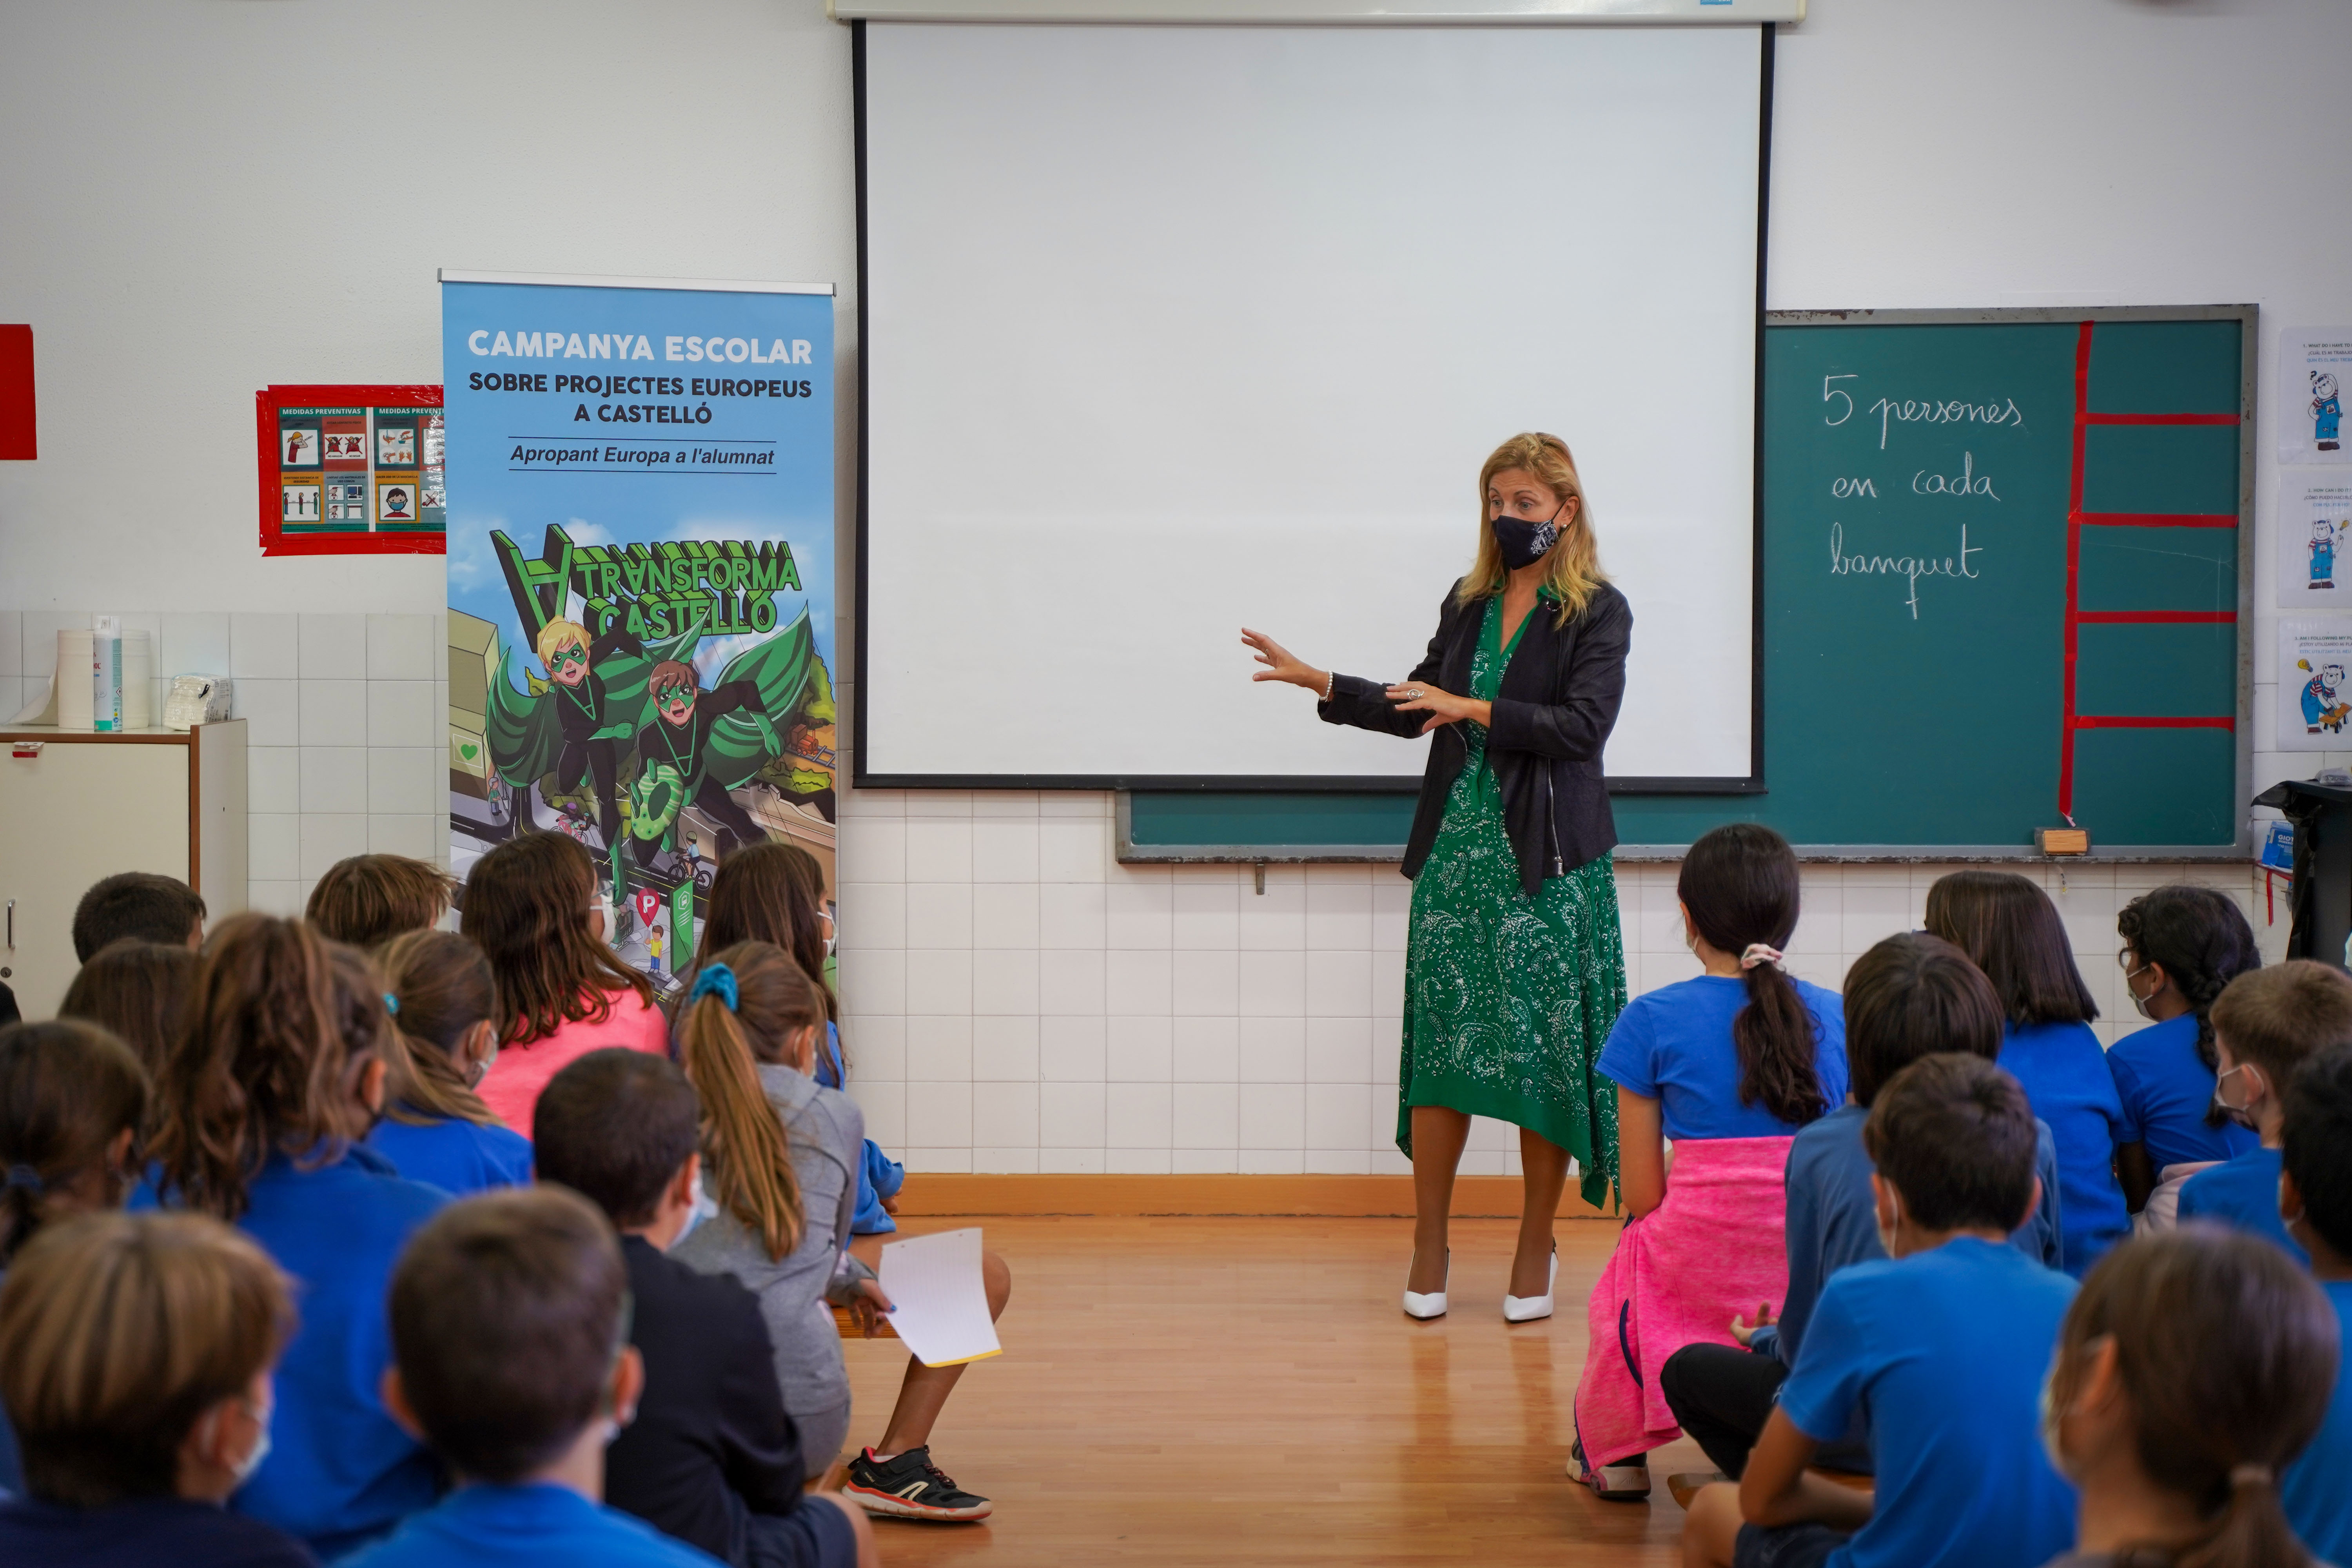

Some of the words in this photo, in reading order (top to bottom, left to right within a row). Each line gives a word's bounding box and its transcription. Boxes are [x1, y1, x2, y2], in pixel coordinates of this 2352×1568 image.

[469, 330, 655, 360] CAMPANYA
[666, 336, 812, 364] ESCOLAR
[470, 372, 548, 392] SOBRE
[555, 375, 684, 398] PROJECTES
[692, 377, 812, 397] EUROPEUS
[574, 403, 590, 422] A
[597, 401, 712, 424] CASTELLÓ
[1824, 375, 1858, 425] 5
[1870, 398, 2022, 449] persones
[510, 445, 599, 465] Apropant
[604, 446, 670, 466] Europa
[675, 451, 686, 463] a
[692, 447, 775, 465] l'alumnat
[1832, 477, 1878, 497] en
[1913, 451, 2000, 501] cada
[572, 547, 802, 599] TRANSFORMA
[1831, 522, 1983, 619] banquet
[643, 895, 655, 913] P
